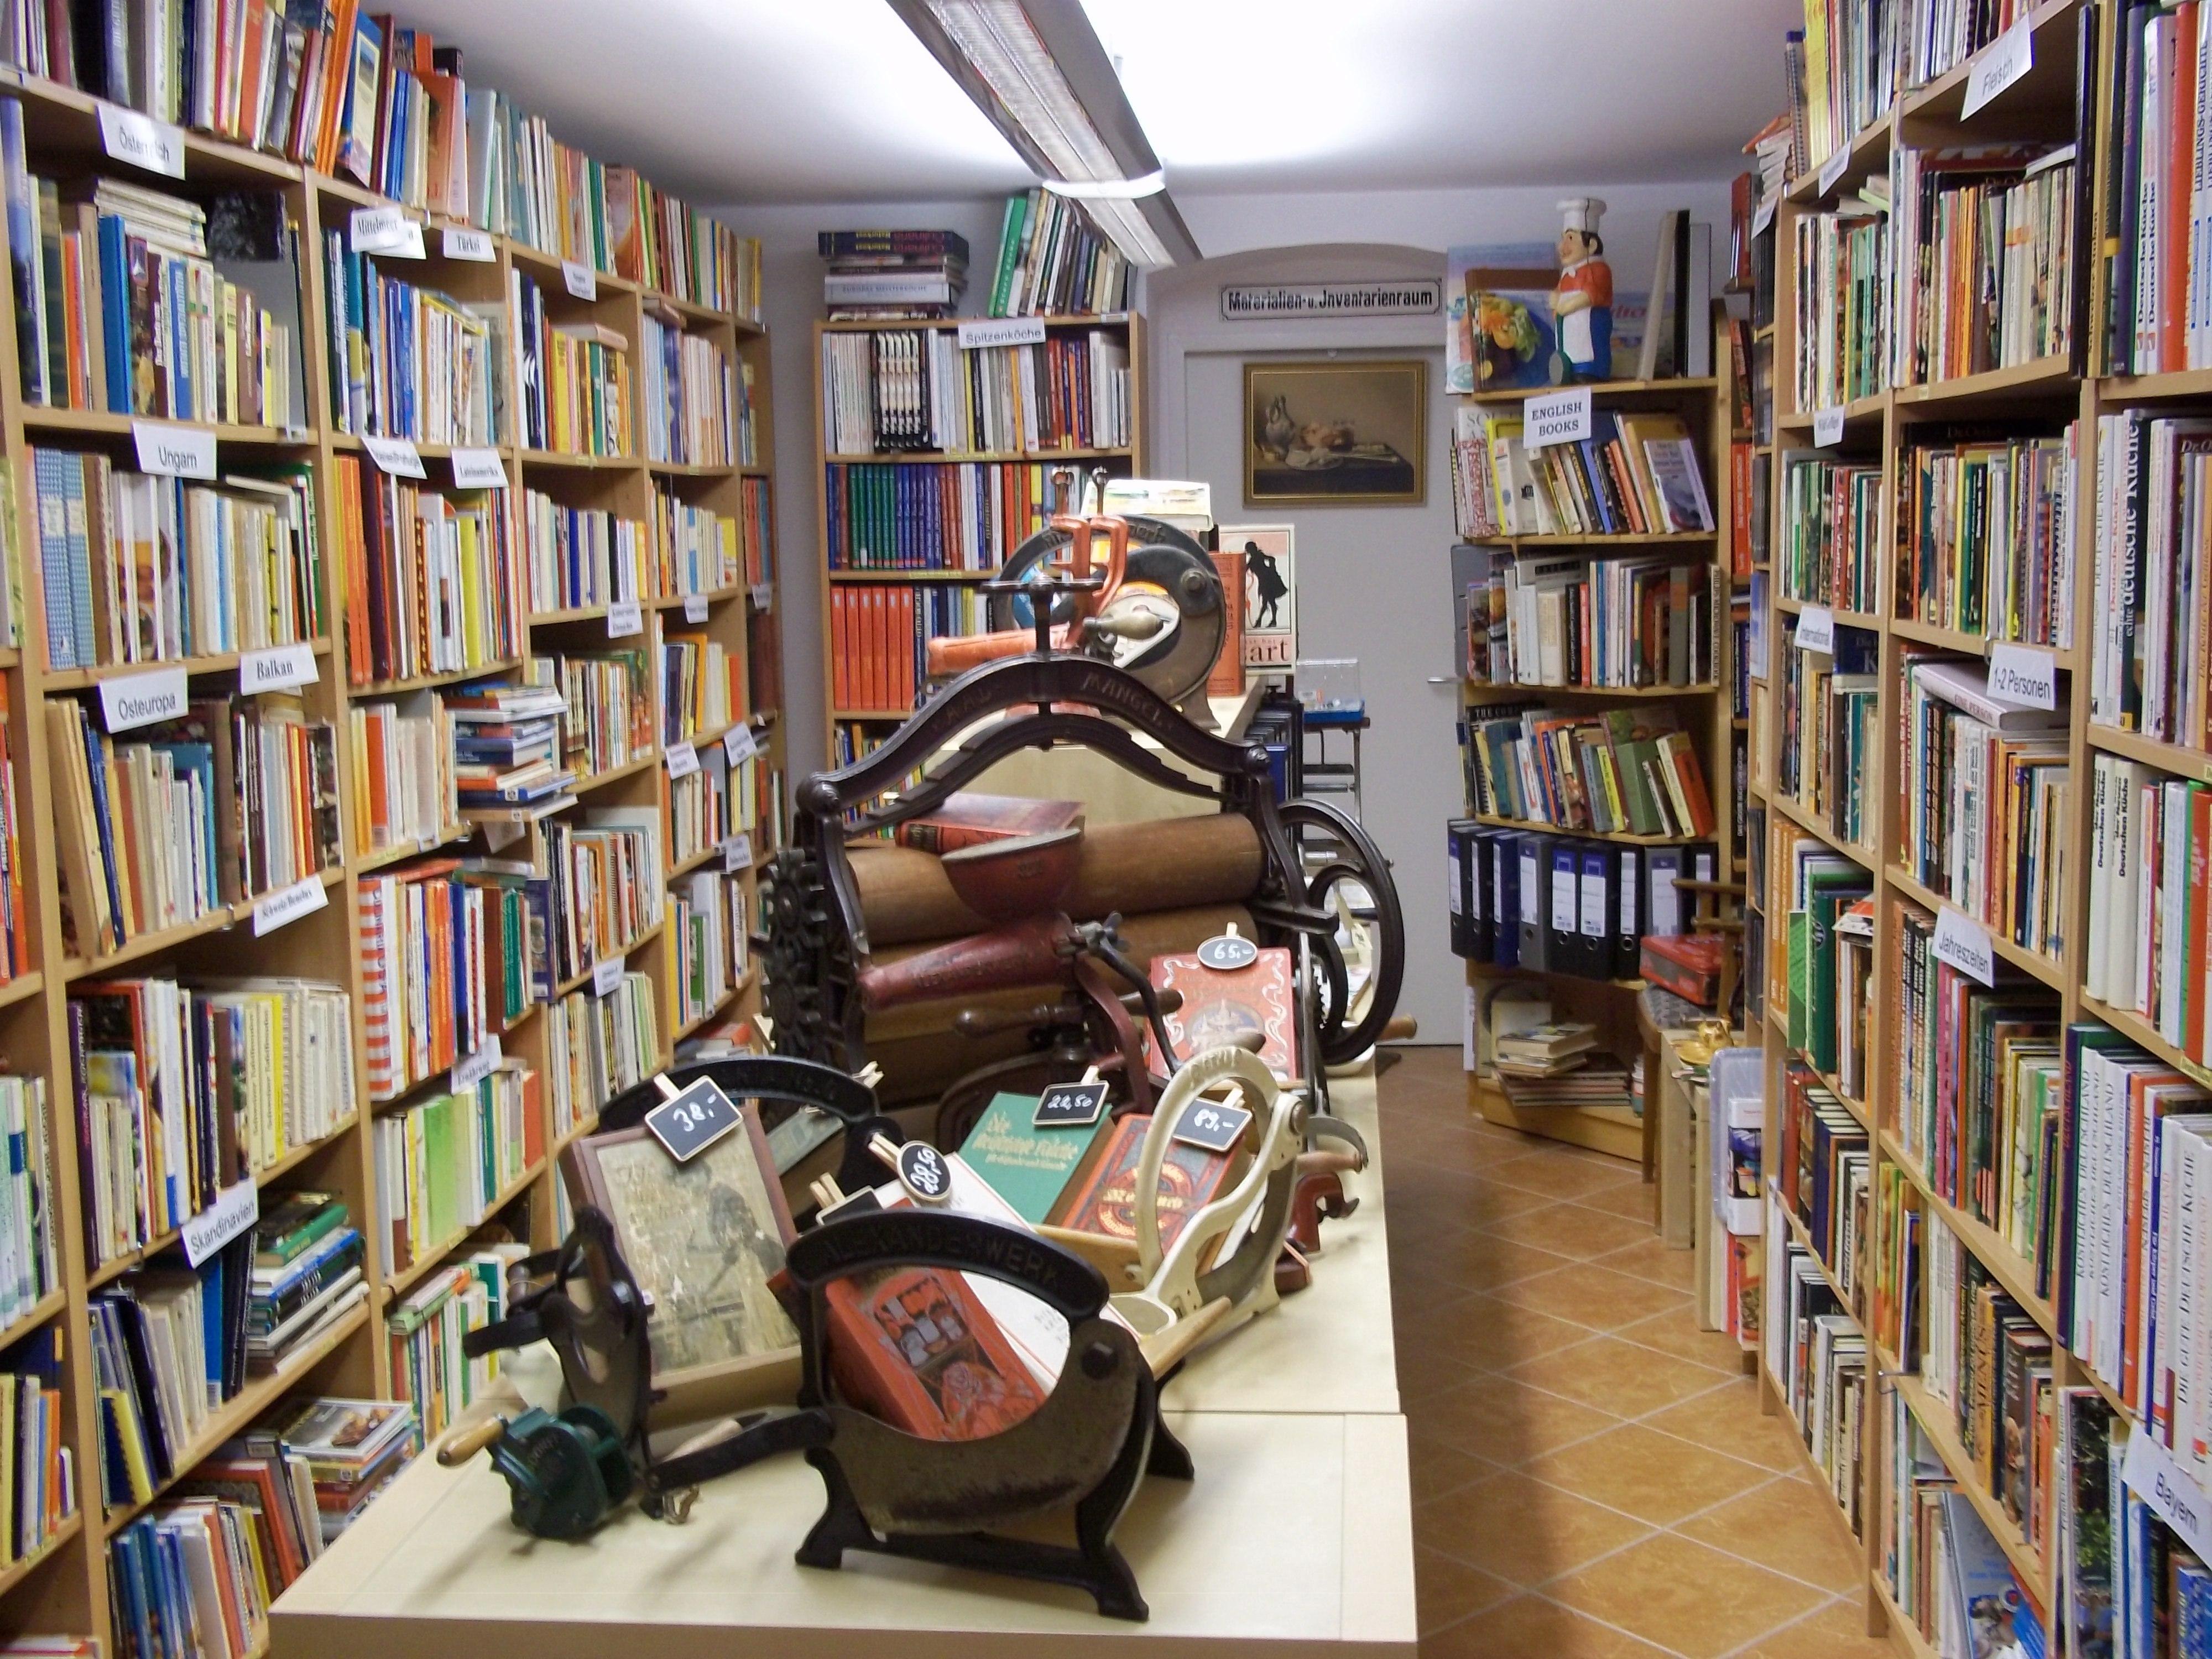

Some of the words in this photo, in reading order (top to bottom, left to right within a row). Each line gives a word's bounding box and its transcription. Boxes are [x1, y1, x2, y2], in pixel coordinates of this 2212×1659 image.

[1983, 58, 2014, 97] Fleisch
[2140, 182, 2148, 238] Küche
[457, 234, 481, 253] Türkei
[2138, 241, 2147, 324] Deutsche
[966, 327, 1041, 346] Spitzenköche
[1531, 401, 1582, 421] ENGLISH
[1538, 420, 1579, 437] BOOKS
[158, 445, 197, 473] Ungarn
[2122, 508, 2137, 605] deutsche
[256, 658, 294, 680] Balkan
[1994, 667, 2006, 690] 1-2
[2007, 670, 2050, 700] Personen
[118, 693, 176, 720] Osteuropa
[2097, 808, 2105, 868] Deutschen
[2118, 816, 2127, 877] Deutschen
[1214, 942, 1253, 959] 65,-
[1939, 932, 1989, 972] Jahreszeiten
[2078, 1071, 2090, 1179] DEUTSCHLAND
[2101, 1083, 2114, 1196] DEUTSCHLAND
[910, 1146, 942, 1194] 28,50
[190, 1201, 255, 1254] Skandinavien
[2179, 1217, 2194, 1316] DEUTSCHE
[2179, 1318, 2191, 1368] GUTE
[2177, 1374, 2189, 1405] DIE
[2154, 1471, 2199, 1537] Bayern
